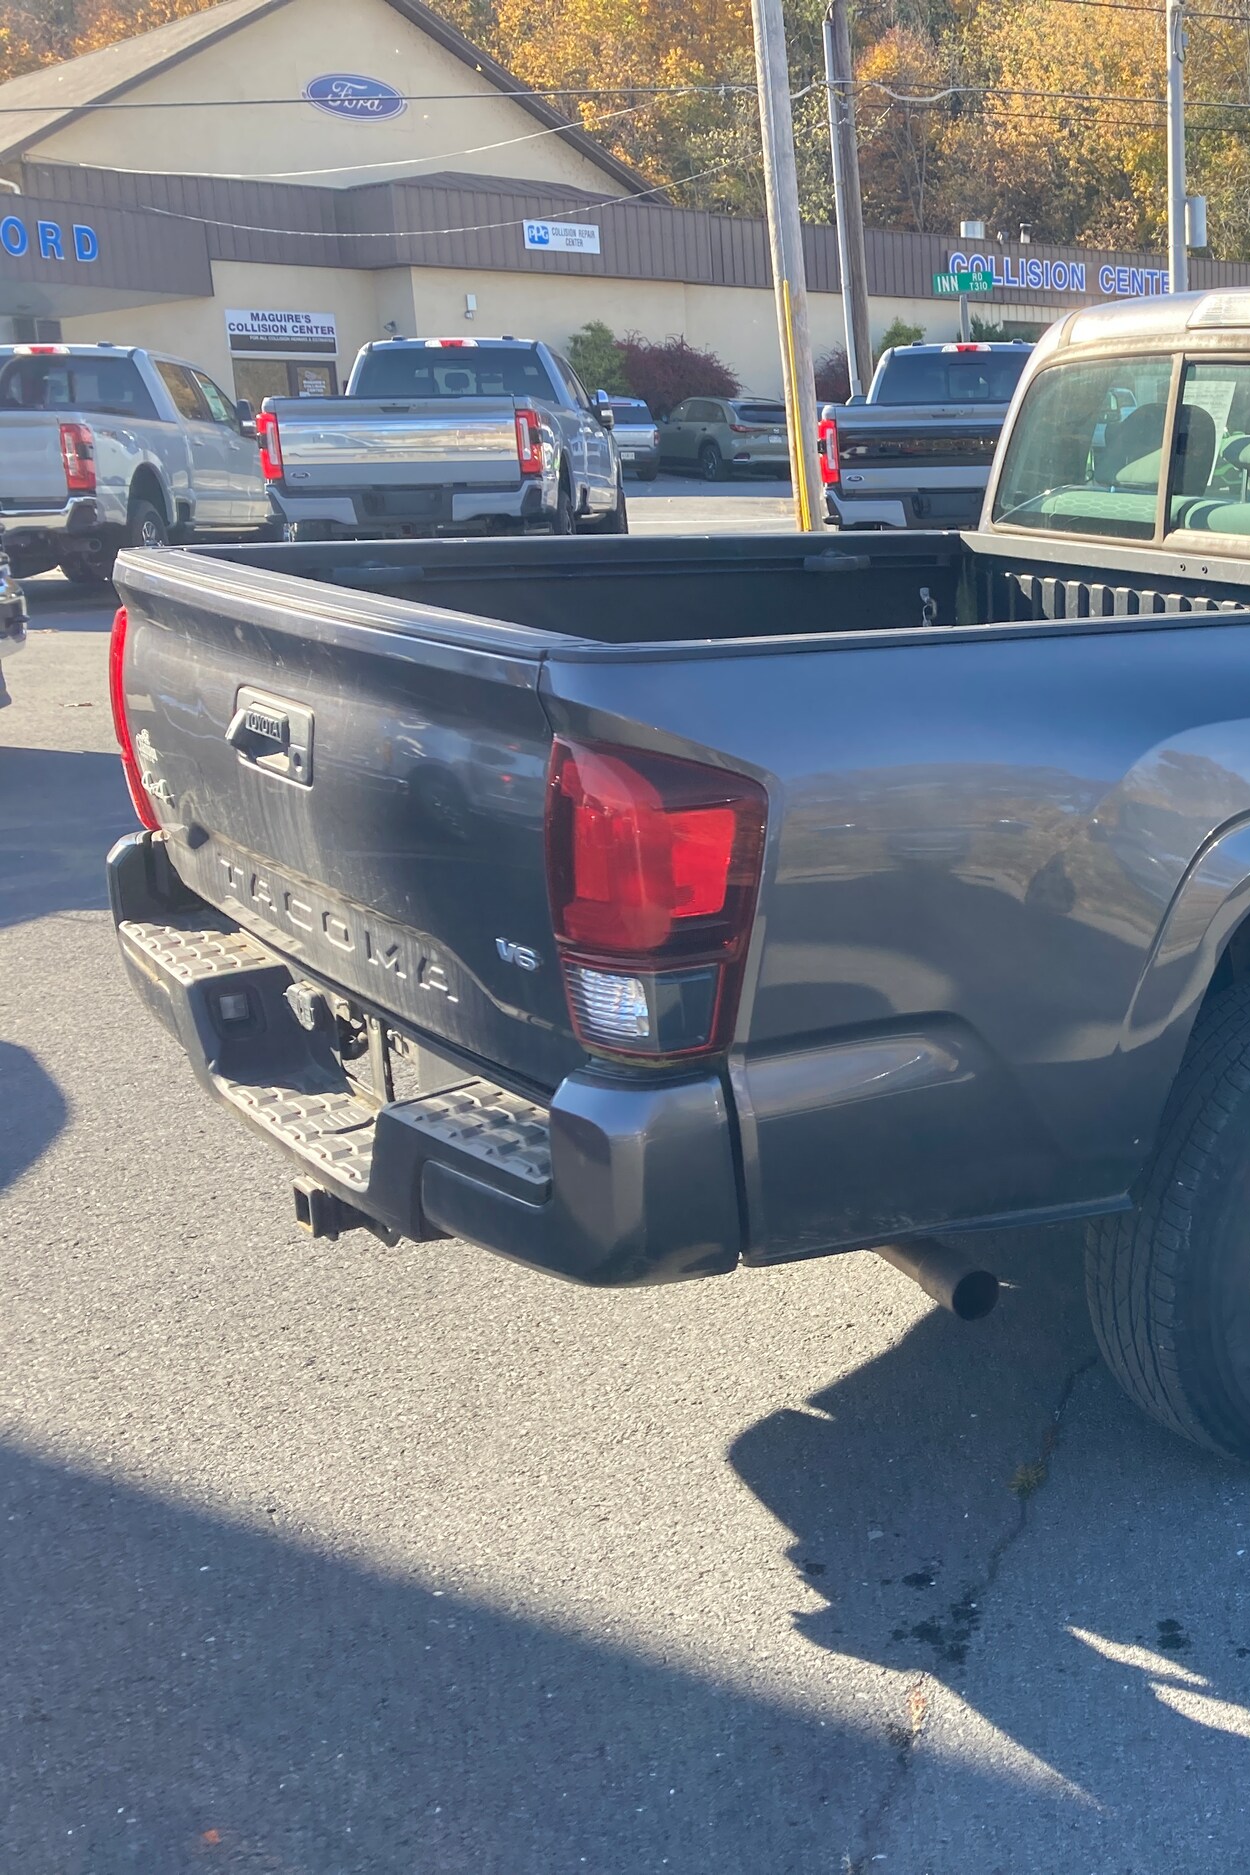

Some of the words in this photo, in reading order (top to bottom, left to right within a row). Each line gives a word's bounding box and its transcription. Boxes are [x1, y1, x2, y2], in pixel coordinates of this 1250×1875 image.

[328, 81, 383, 111] Ford
[0, 216, 99, 262] ORD
[529, 227, 549, 241] PPG
[551, 227, 577, 237] COLLISION
[578, 229, 596, 239] REPAIR
[565, 237, 584, 247] CENTER
[949, 252, 1086, 291] COLLISION
[1099, 265, 1169, 295] CENTE
[972, 272, 983, 281] RD
[937, 275, 959, 292] INN
[969, 281, 988, 291] T310
[250, 312, 312, 324] MAGUIRE'S
[228, 322, 288, 334] COLLISION
[291, 325, 335, 335] CENTER
[246, 710, 282, 742] TOYOTA
[219, 857, 460, 1003] TACOMA
[495, 937, 537, 971] V6
